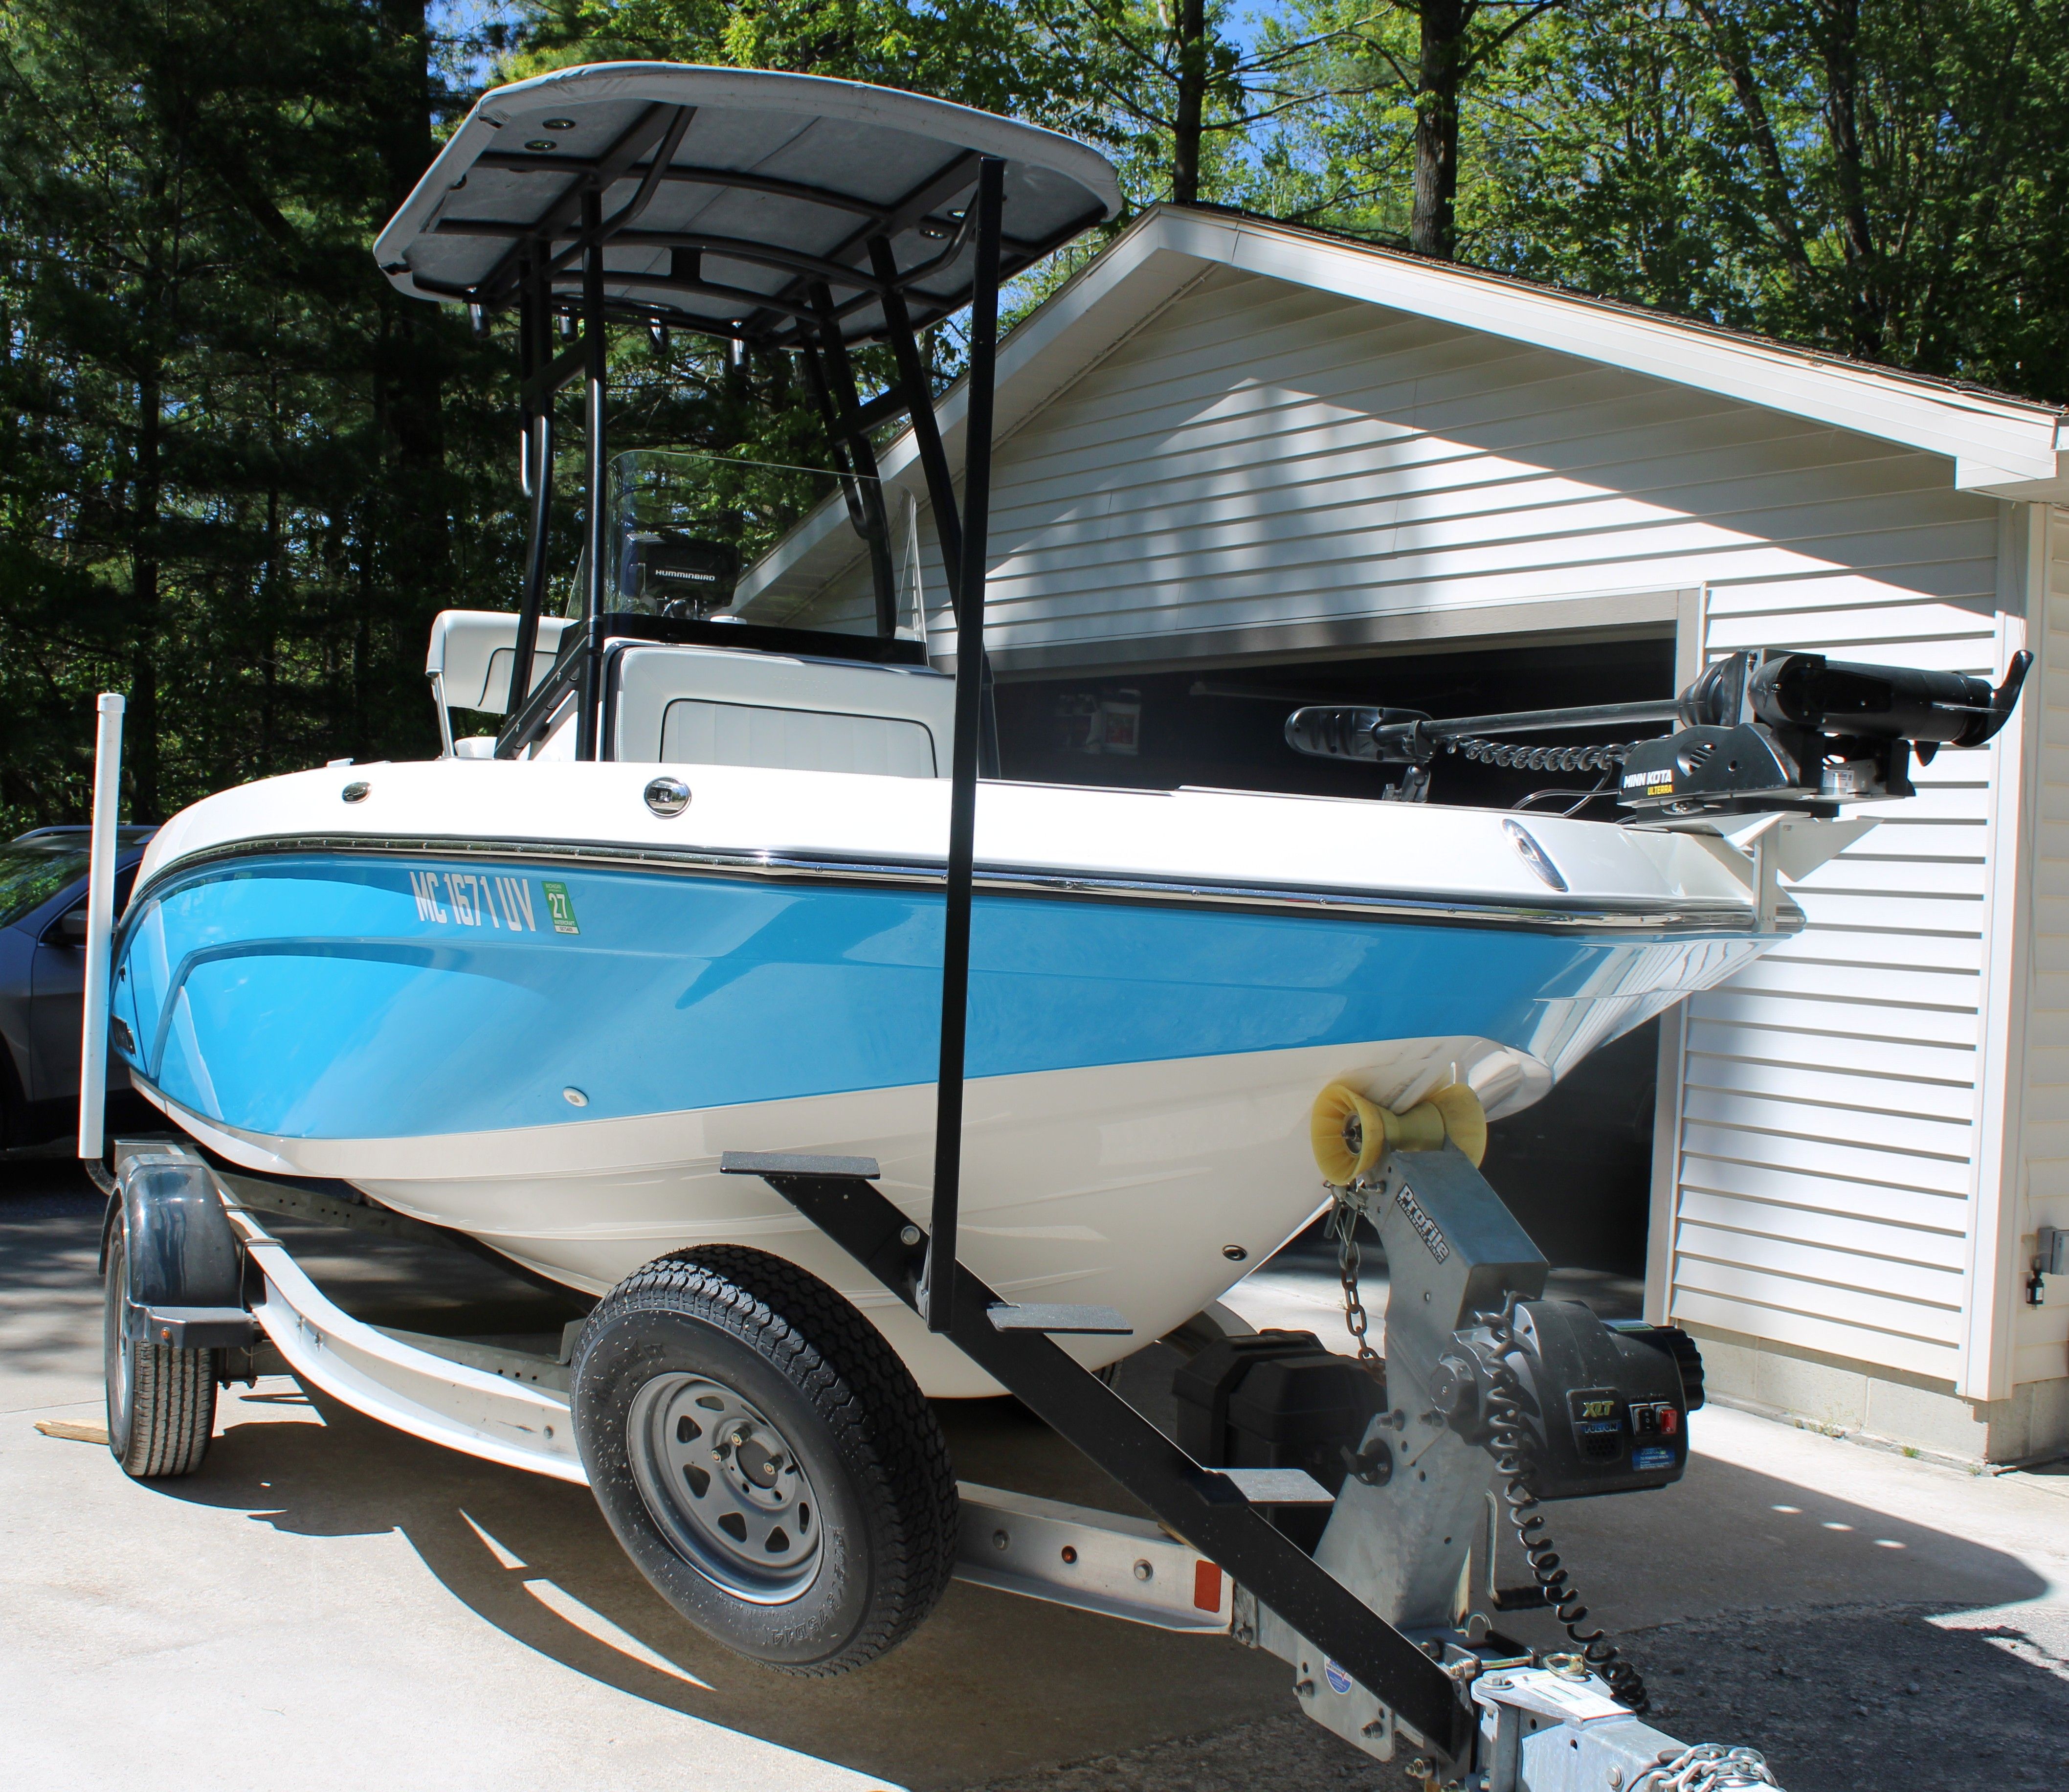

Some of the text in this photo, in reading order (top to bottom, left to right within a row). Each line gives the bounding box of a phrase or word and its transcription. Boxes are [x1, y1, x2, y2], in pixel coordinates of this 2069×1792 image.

[655, 569, 715, 582] HUMMINBIRD
[1623, 769, 1673, 789] MINN KOTA
[1647, 784, 1673, 796] ULTERRA
[409, 872, 536, 932] MC 1671 UV
[548, 893, 568, 919] 27
[1397, 1197, 1443, 1263] PERFORMANCE WINCH
[1398, 1184, 1449, 1259] Profile
[1582, 1401, 1615, 1417] XLT
